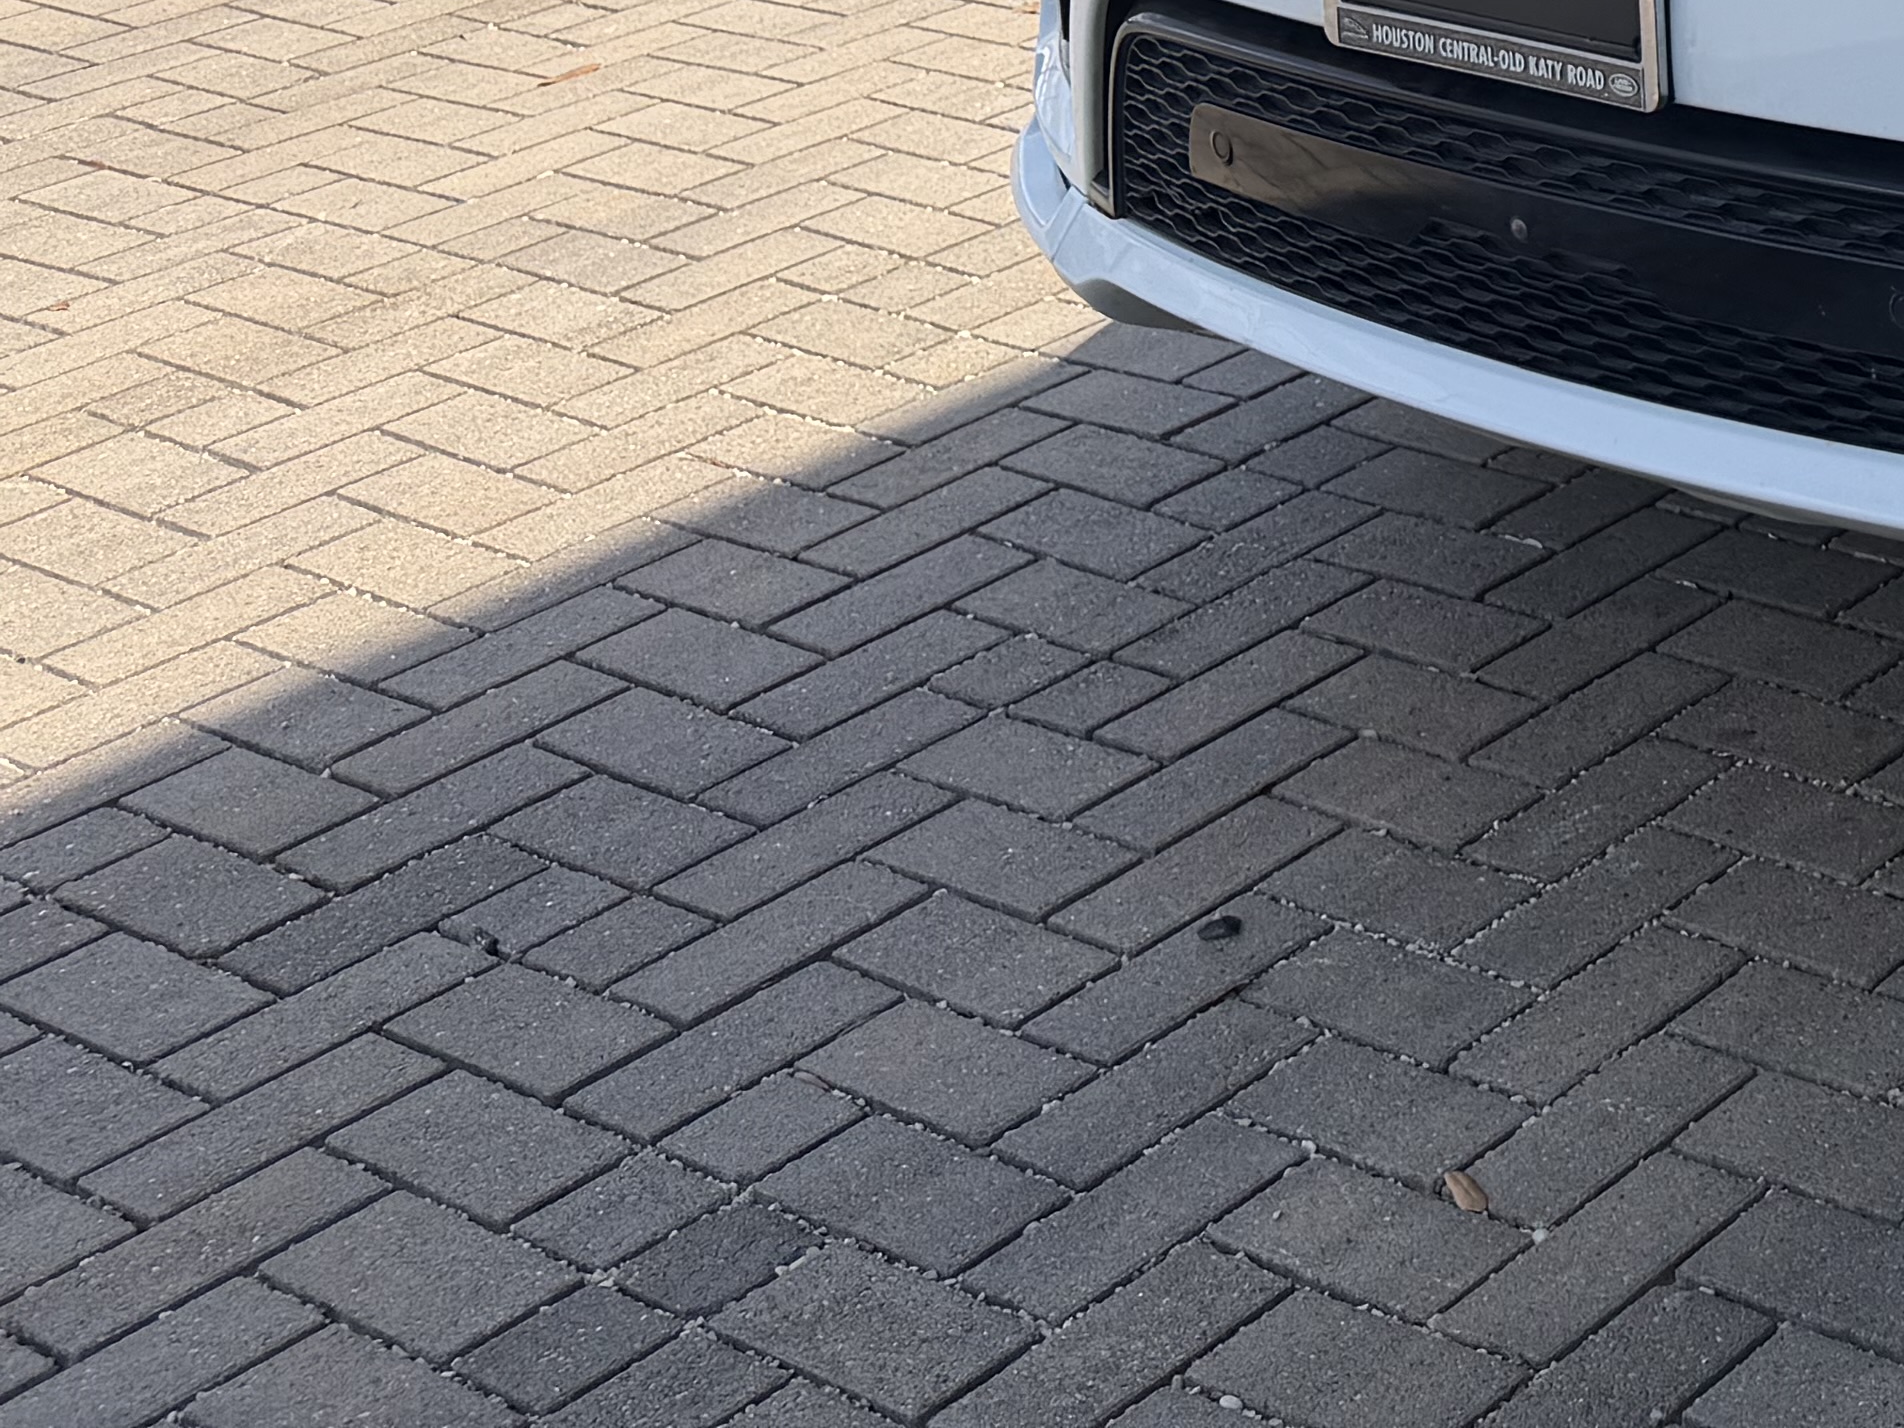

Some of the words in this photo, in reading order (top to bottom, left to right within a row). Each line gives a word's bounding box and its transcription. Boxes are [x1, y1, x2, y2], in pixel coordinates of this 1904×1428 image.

[1372, 23, 1434, 54] HOUSTON
[1529, 55, 1563, 81] KATY
[1567, 64, 1605, 90] ROAD
